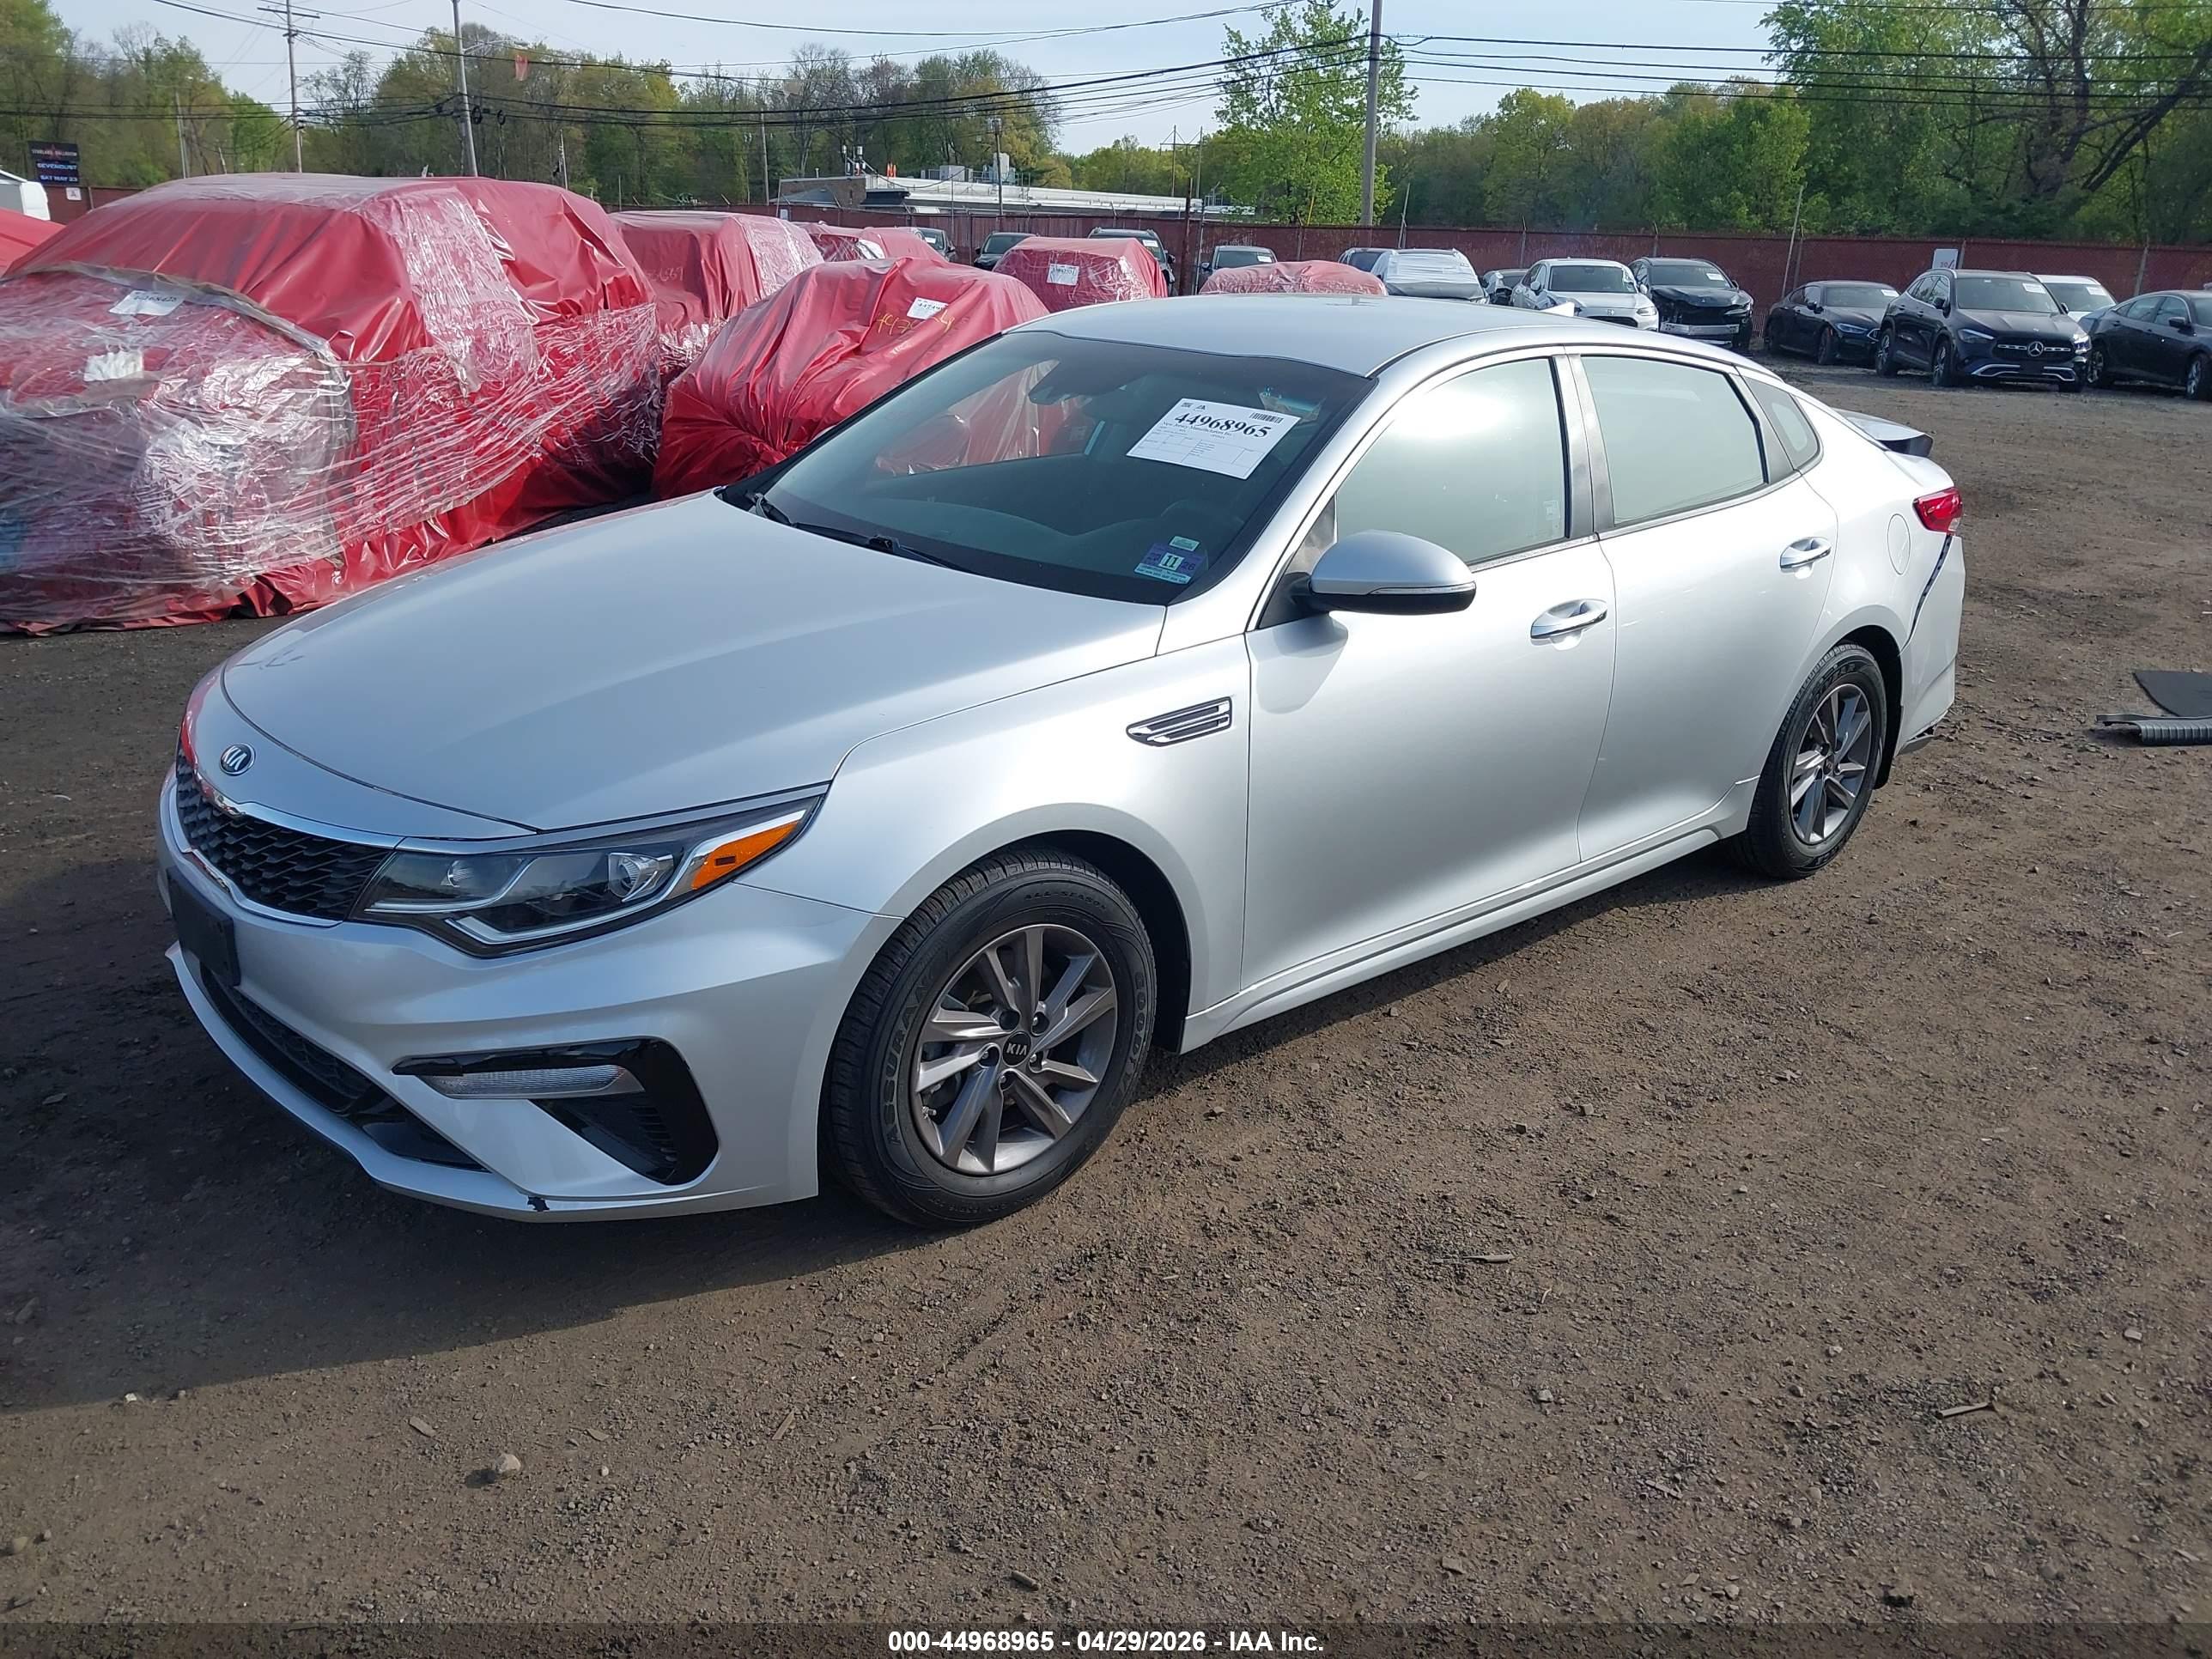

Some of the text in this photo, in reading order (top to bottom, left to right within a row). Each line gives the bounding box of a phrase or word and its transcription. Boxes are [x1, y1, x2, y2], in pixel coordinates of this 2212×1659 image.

[1175, 412, 1272, 438] 44968965
[1163, 555, 1179, 568] 11
[222, 745, 247, 771] KIA
[1006, 1042, 1027, 1056] KIA
